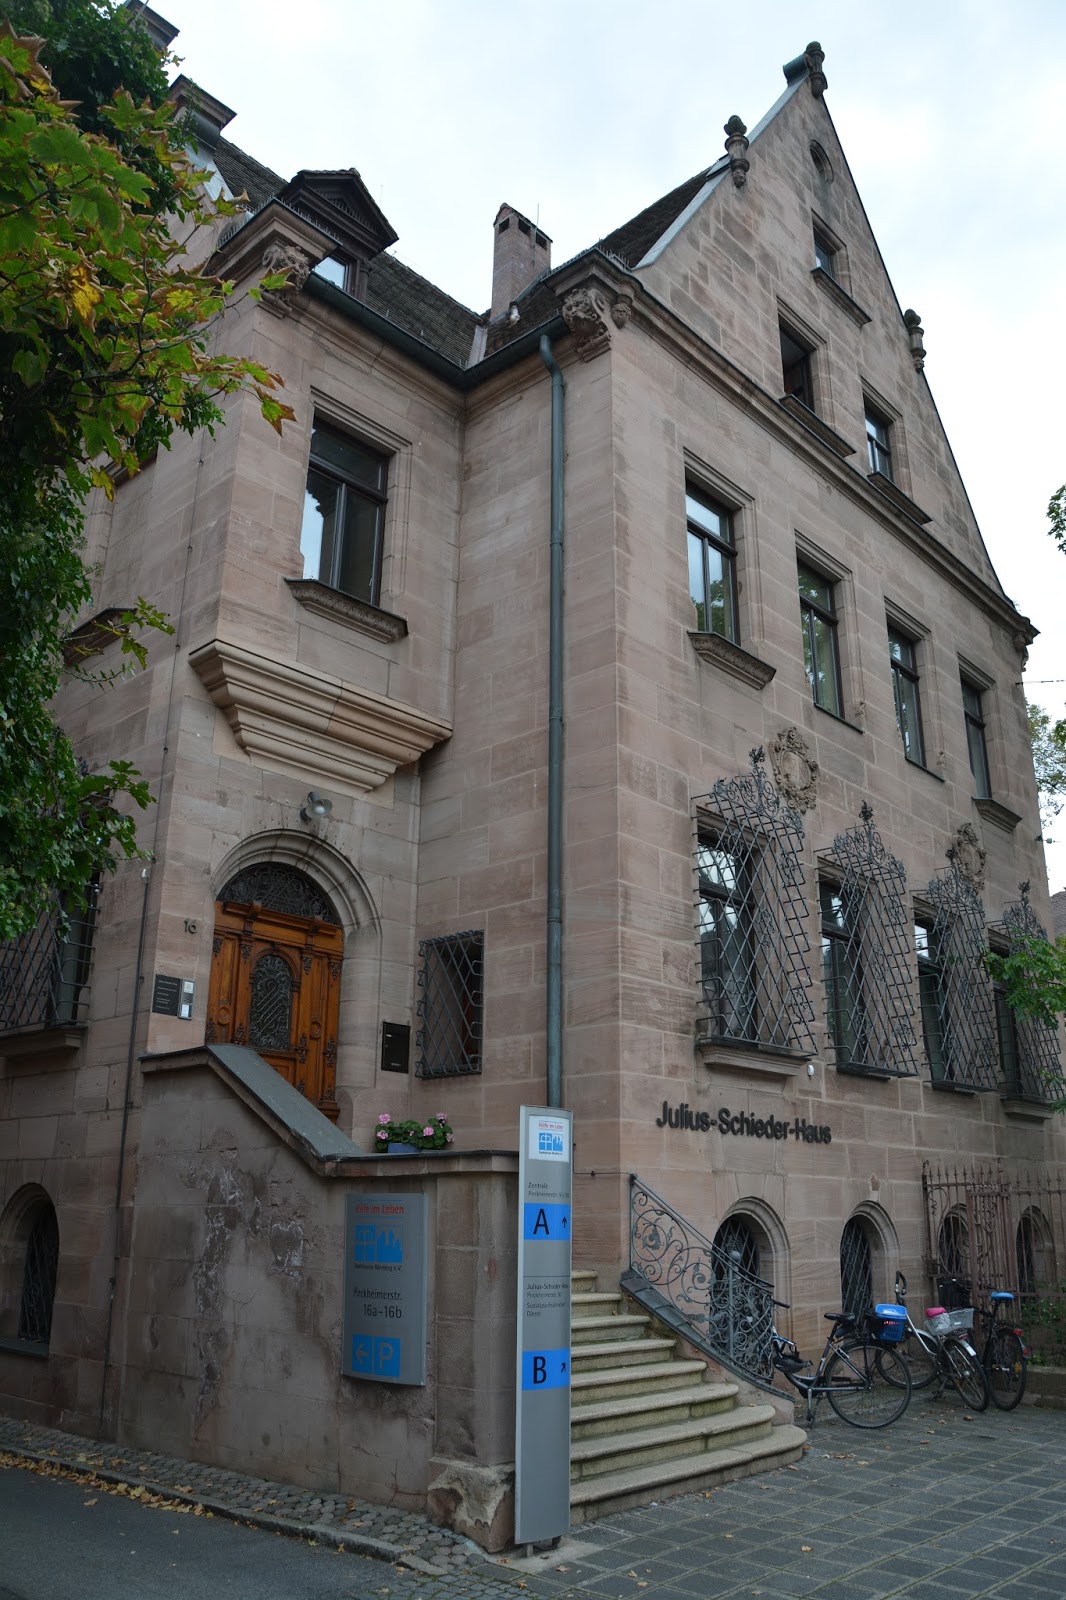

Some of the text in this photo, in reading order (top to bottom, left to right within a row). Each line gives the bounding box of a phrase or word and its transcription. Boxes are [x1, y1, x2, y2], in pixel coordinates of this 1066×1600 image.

[184, 917, 197, 934] 16
[656, 1100, 832, 1145] Julius-Schieder-Haus
[528, 1181, 548, 1189] Zentrale
[381, 1202, 405, 1215] Leben
[533, 1208, 550, 1235] A
[379, 1341, 394, 1370] P
[533, 1355, 547, 1385] B
